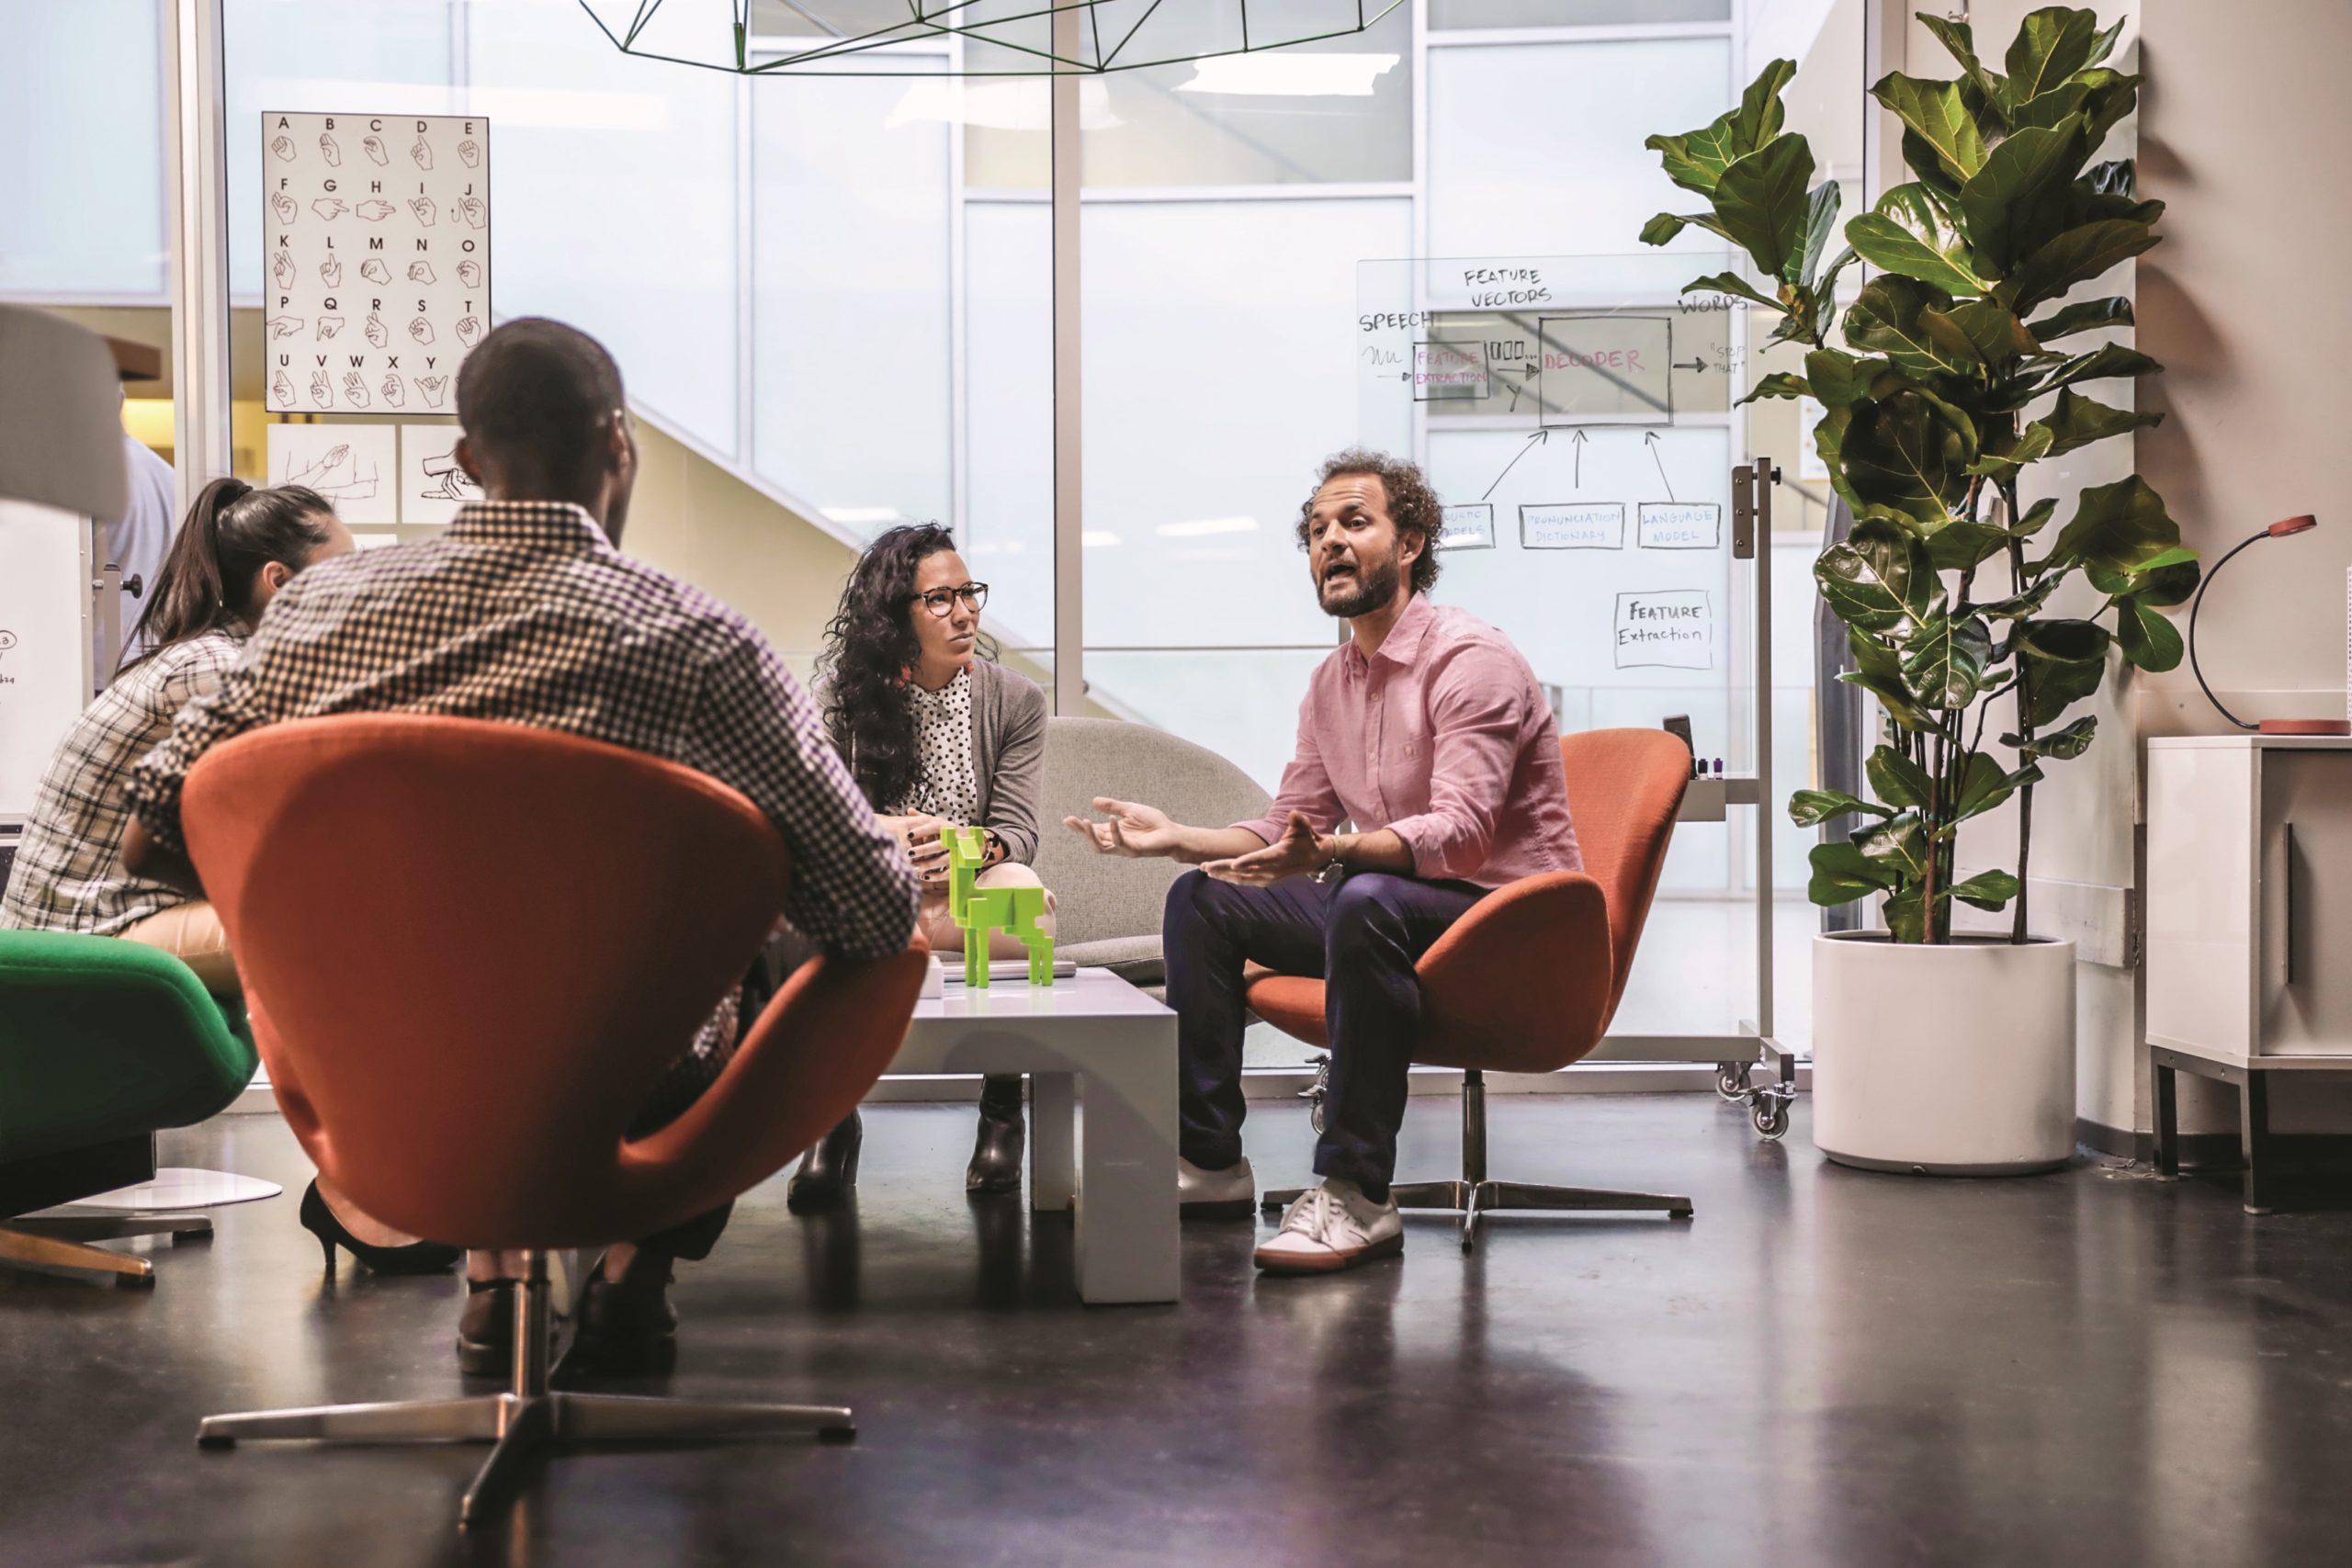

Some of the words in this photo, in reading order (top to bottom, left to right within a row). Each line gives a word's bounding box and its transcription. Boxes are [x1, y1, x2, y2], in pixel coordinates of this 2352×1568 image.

[277, 116, 290, 130] A
[325, 118, 335, 130] B
[369, 118, 382, 132] C
[416, 120, 427, 133] D
[464, 121, 472, 135] E
[280, 177, 288, 191] F
[323, 179, 337, 192] G
[371, 180, 381, 194] H
[464, 183, 472, 197] J
[279, 234, 288, 248] K
[327, 236, 334, 249] L
[369, 237, 383, 250] M
[416, 238, 427, 252] N
[461, 239, 475, 253] O
[1464, 268, 1542, 287] FEATURE
[280, 296, 289, 309] P
[323, 297, 337, 310] Q
[372, 298, 381, 311] R
[417, 299, 426, 312] S
[464, 300, 472, 313] T
[1472, 288, 1552, 308] VECTORS
[1678, 295, 1748, 315] WORDS
[1359, 310, 1434, 333] SPEECH
[279, 354, 289, 367] U
[316, 355, 327, 367] V
[349, 355, 365, 368] W
[388, 355, 399, 369] X
[425, 356, 436, 369] Y
[1417, 351, 1480, 365] FEATURE
[1544, 349, 1645, 372] DECODER
[1416, 372, 1487, 386] EXTRACTION
[1643, 510, 1713, 525] LANGUAGE
[1653, 531, 1701, 543] MODEL
[1629, 601, 1703, 621] FEATURE
[1618, 626, 1702, 646] Extraction
